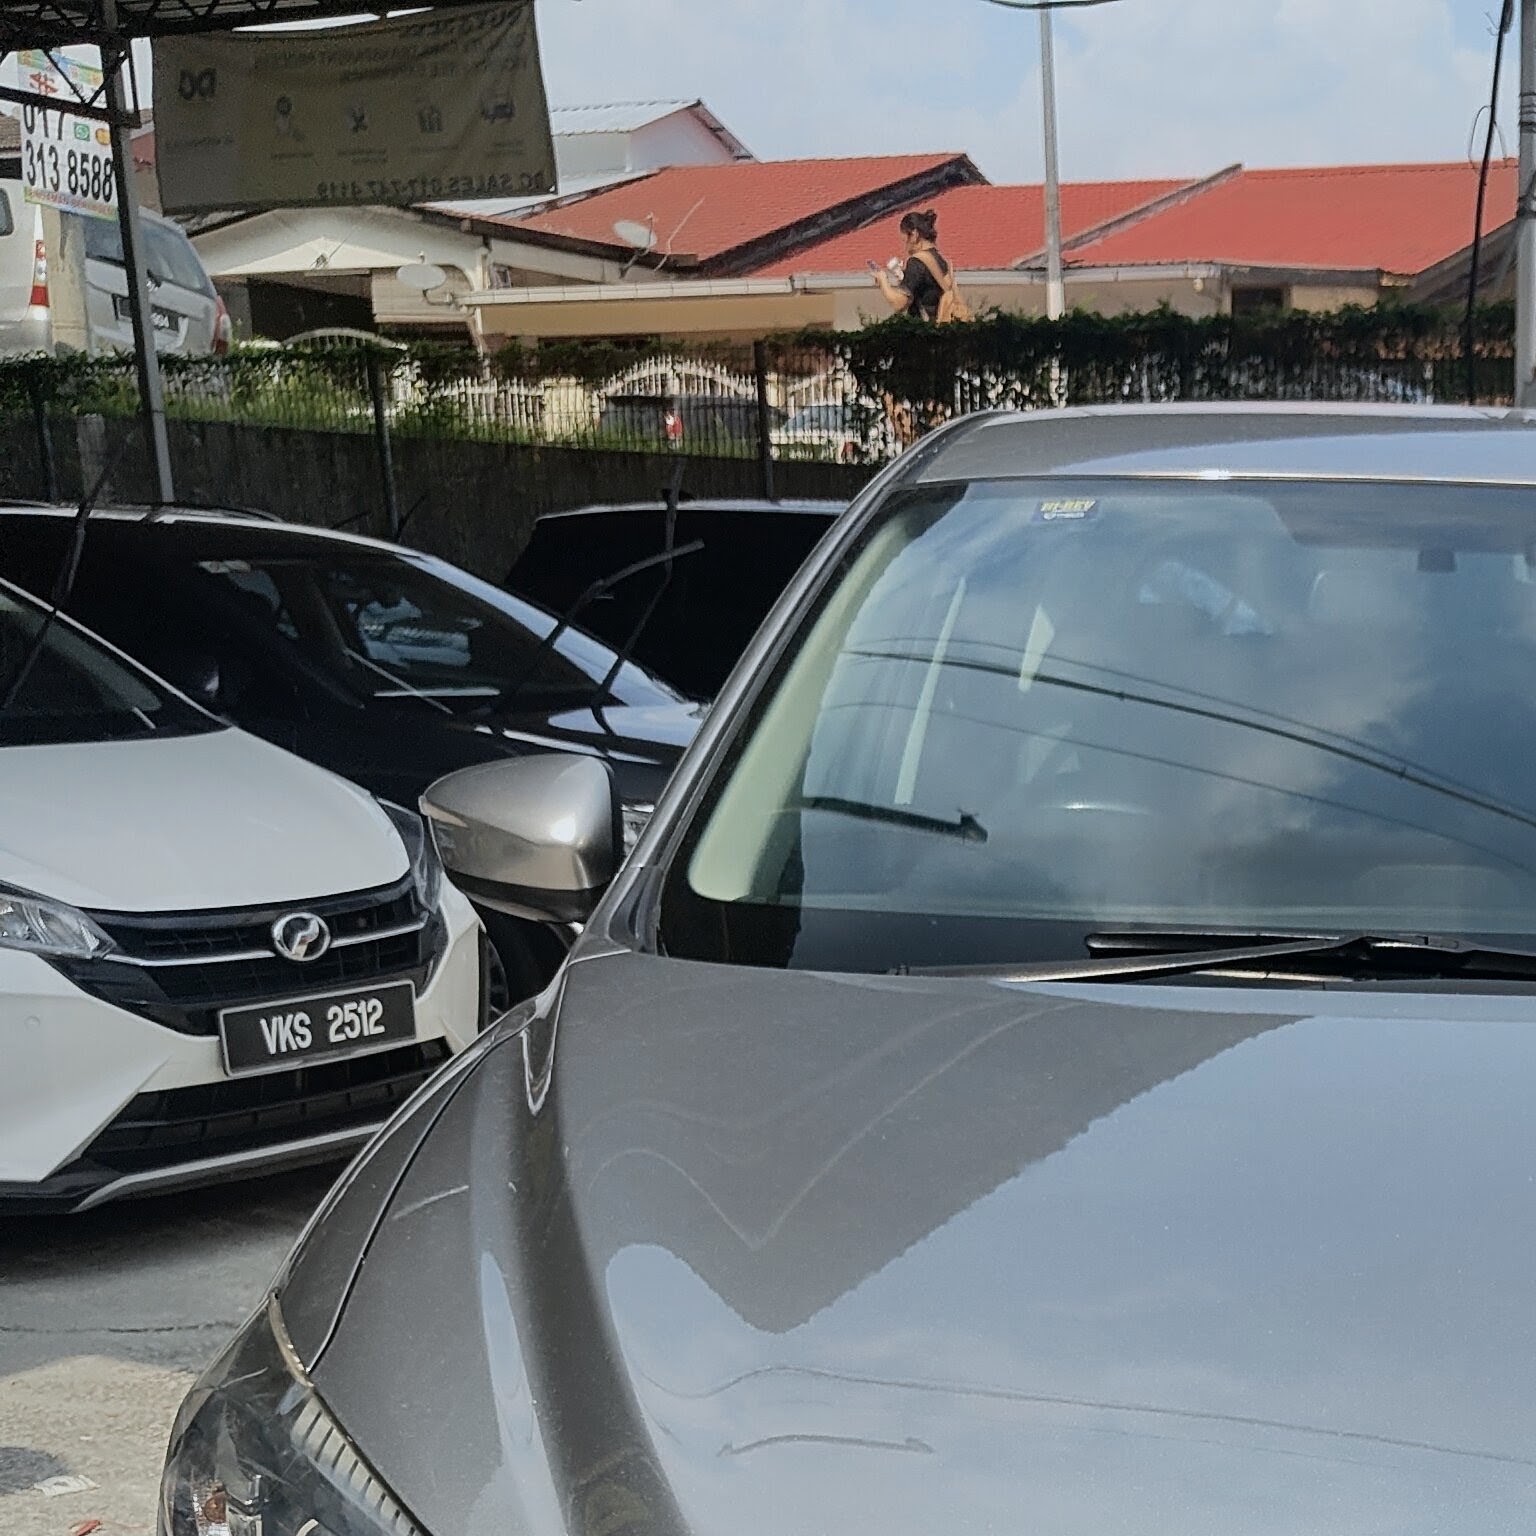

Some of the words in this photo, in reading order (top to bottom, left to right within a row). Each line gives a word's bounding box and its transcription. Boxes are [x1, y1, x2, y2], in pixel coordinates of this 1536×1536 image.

[26, 139, 60, 192] 313
[67, 149, 113, 203] 8588
[259, 1011, 313, 1055] VKS
[327, 998, 385, 1043] 2512
